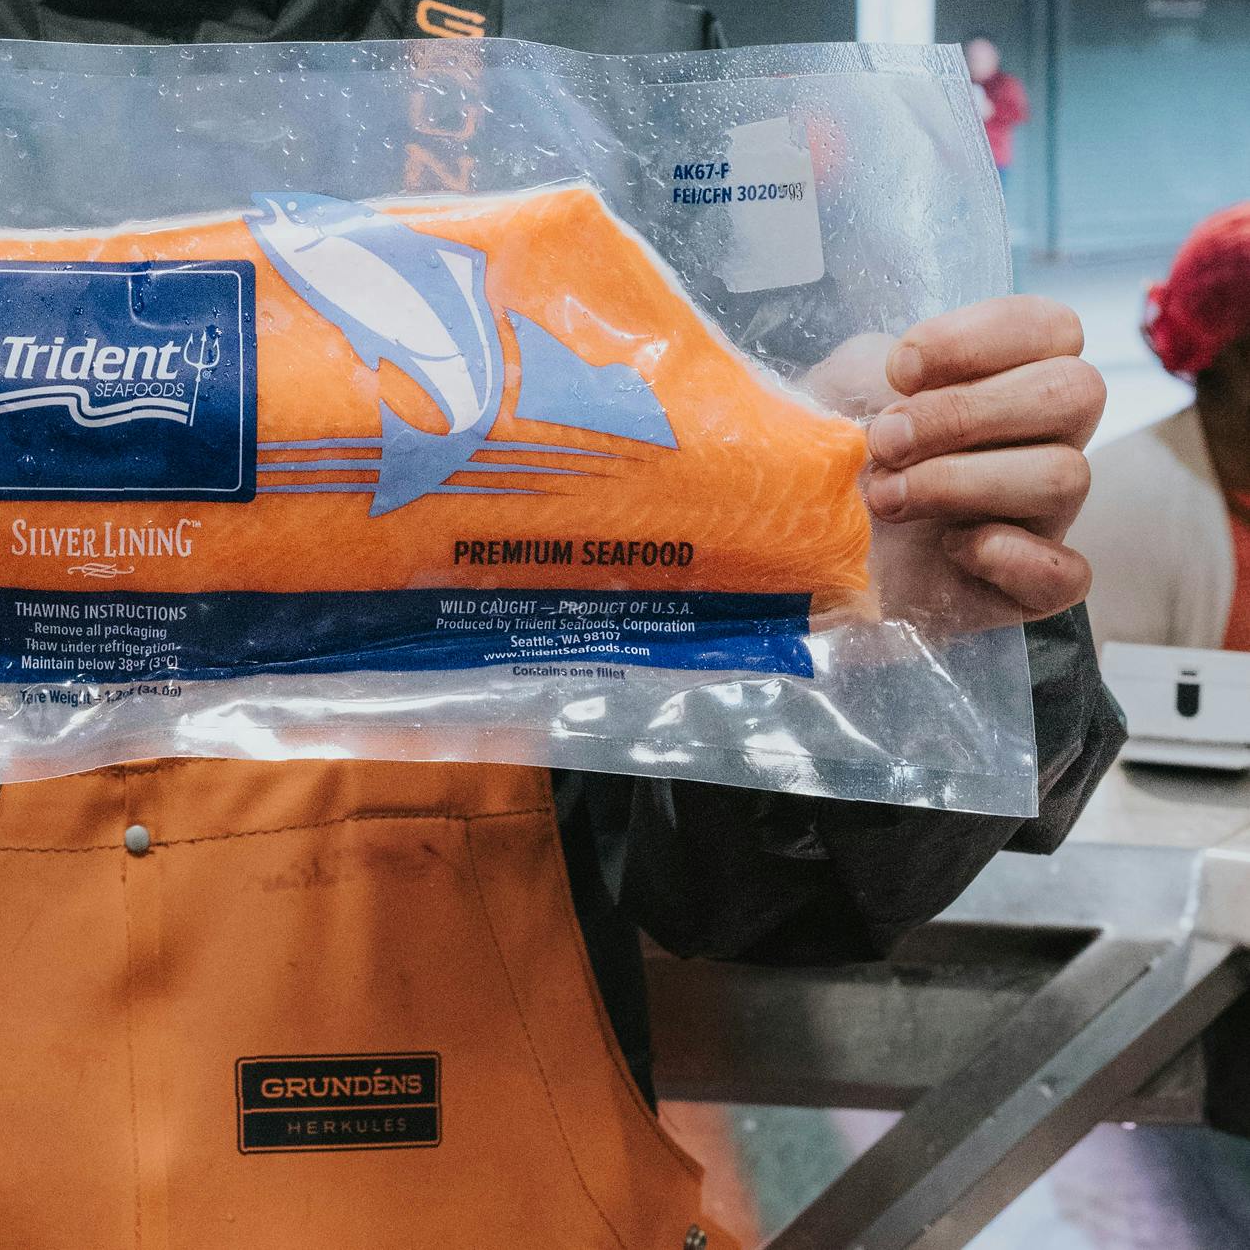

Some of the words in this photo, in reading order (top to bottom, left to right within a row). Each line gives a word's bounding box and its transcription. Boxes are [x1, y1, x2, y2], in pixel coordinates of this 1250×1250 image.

[673, 162, 730, 181] AK67-F
[673, 186, 732, 205] FEI/CFN
[2, 336, 181, 380] Trident
[94, 382, 185, 398] SEAFOODS
[11, 518, 100, 558] SILVER
[453, 540, 574, 566] PREMIUM
[581, 540, 694, 567] SEAFOOD
[15, 601, 80, 619] THAWING
[85, 603, 187, 621] INSTRUCTIONS
[440, 600, 476, 614] WILD
[480, 600, 537, 614] CAUGHT
[558, 600, 626, 615] PRODUCT
[630, 601, 648, 615] OF
[652, 602, 694, 615] U.S.A.
[34, 622, 83, 636] Remove
[86, 624, 100, 636] all
[104, 624, 167, 640] packaging
[436, 618, 493, 631] Produced
[496, 618, 511, 632] by
[515, 618, 556, 631] Trident
[559, 618, 619, 632] Seafoods,
[622, 618, 695, 633] Corporation
[25, 637, 57, 651] Thaw
[61, 639, 98, 653] under
[100, 639, 176, 658] refrigeration
[510, 635, 558, 649] Seattle,
[561, 634, 581, 645] WA
[583, 631, 621, 643] 98107
[483, 643, 650, 661] www.TridentSeafoods.com
[21, 655, 74, 670] Maintain
[78, 657, 115, 671] below
[512, 665, 567, 678] Contains
[570, 668, 594, 678] one
[596, 667, 626, 680] fillet
[21, 690, 46, 705] Tare
[260, 1067, 423, 1099] GRUNDÉNS
[286, 1117, 407, 1136] HERKULES
